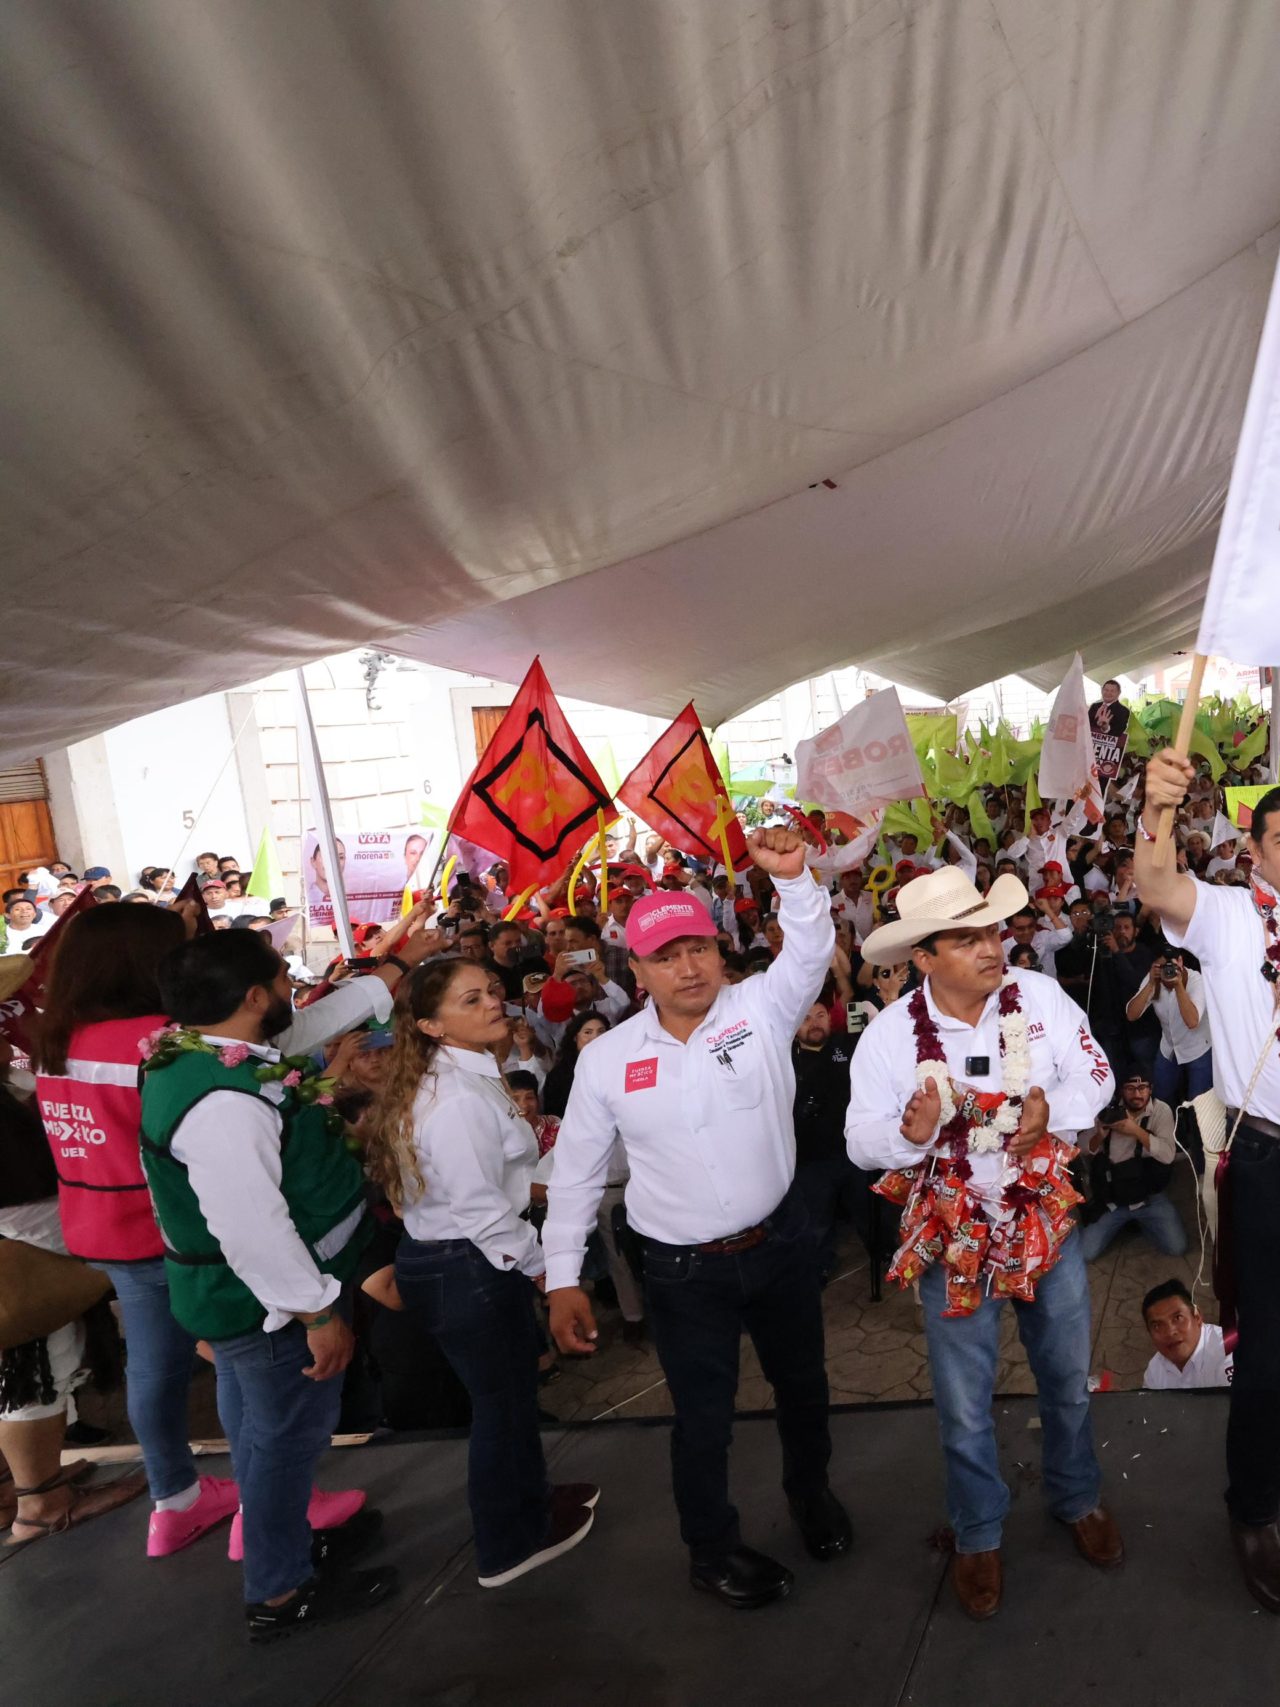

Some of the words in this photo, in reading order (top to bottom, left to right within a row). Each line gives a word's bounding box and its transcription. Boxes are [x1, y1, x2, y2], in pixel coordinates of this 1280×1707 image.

[1091, 732, 1117, 743] MENTA
[1094, 744, 1120, 763] ENTA
[423, 779, 432, 795] 6
[182, 810, 195, 829] 5
[359, 834, 389, 844] VOTA
[354, 852, 384, 860] morena
[651, 904, 694, 917] CLEMENTE
[706, 1020, 749, 1044] CLEMENTE
